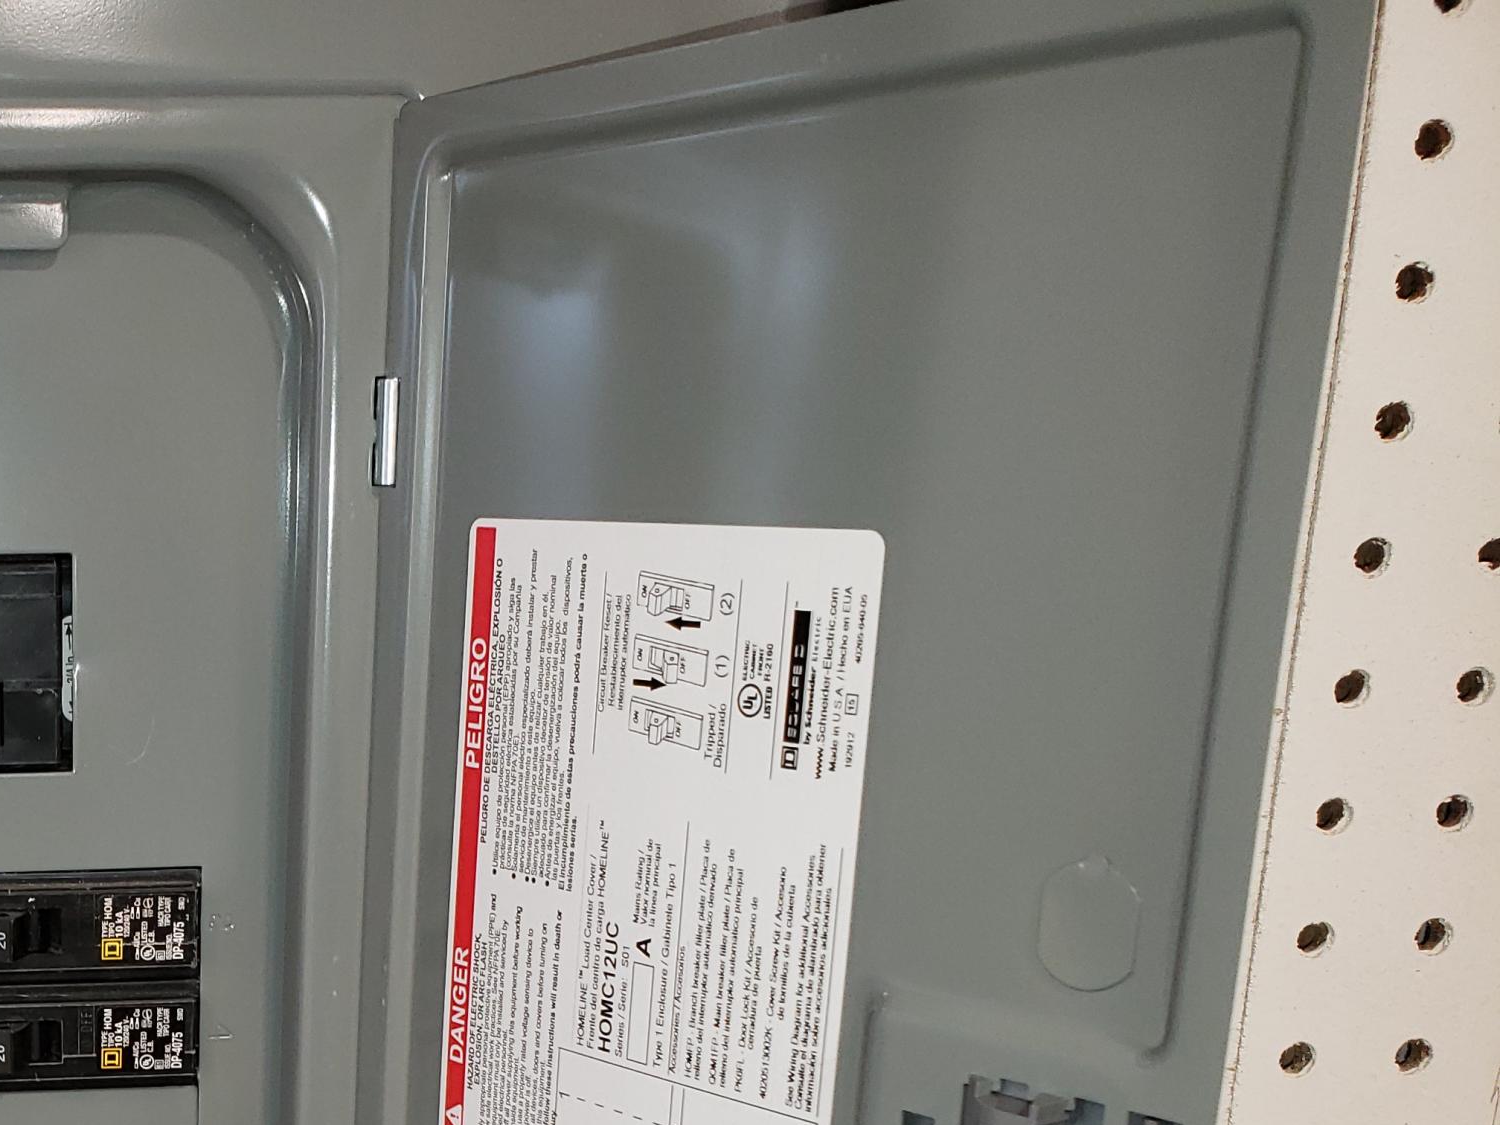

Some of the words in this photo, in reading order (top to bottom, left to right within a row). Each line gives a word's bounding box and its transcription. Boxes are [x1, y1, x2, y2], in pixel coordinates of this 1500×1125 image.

[493, 556, 503, 568] O
[491, 567, 502, 637] EXPLOSIÓN
[603, 599, 612, 631] Reset
[719, 592, 735, 616] (2)
[843, 586, 853, 613] EUA
[811, 616, 821, 662] Electric
[842, 616, 850, 631] en
[600, 634, 609, 676] Breaker
[607, 614, 621, 707] Restablecimiento
[714, 654, 730, 678] (1)
[837, 635, 848, 673] Hecho
[487, 640, 499, 708] ELÉCTRICA,
[617, 656, 627, 711] interruptor
[815, 587, 839, 779] www.Schneider-Electric.com
[465, 637, 487, 769] PELIGRO
[491, 714, 501, 774] DESTELLO
[496, 633, 506, 685] ARQUEO
[598, 678, 606, 713] Circuit
[742, 691, 758, 711] UL
[763, 686, 773, 719] LISTED
[804, 666, 816, 728] Schneider
[484, 710, 494, 774] DESCARGA
[704, 712, 718, 761] Tripped
[713, 703, 726, 768] Disparado
[802, 731, 812, 745] by
[831, 725, 839, 736] in
[828, 739, 838, 772] Made
[483, 776, 490, 792] DE
[480, 794, 489, 844] PELIGRO
[646, 838, 653, 852] de
[587, 862, 596, 896] Cover
[635, 856, 645, 890] Rating
[644, 854, 652, 896] nominal
[665, 873, 676, 898] Tipo
[104, 898, 112, 919] HOM
[115, 912, 123, 923] kA
[556, 909, 562, 921] or
[583, 899, 594, 938] Center
[596, 901, 605, 934] carga
[632, 893, 641, 924] Mains
[640, 898, 649, 924] Valor
[115, 926, 123, 938] 10
[173, 922, 184, 960] DP-4075
[553, 922, 561, 950] death
[593, 937, 601, 951] de
[661, 903, 673, 958] Gabinete
[472, 933, 482, 974] SHOCK,
[479, 941, 488, 977] FLASH
[552, 952, 559, 962] in
[581, 940, 591, 969] Load
[636, 938, 652, 958] A
[592, 954, 600, 990] centro
[597, 921, 619, 1053] HOMC12UC
[449, 947, 469, 1064] DANGER
[469, 975, 480, 1028] ELECTRIC
[477, 1004, 484, 1020] OR
[576, 983, 588, 1046] HOMELINE
[589, 992, 597, 1011] del
[614, 1021, 624, 1058] Series
[621, 945, 630, 968] S01
[655, 968, 668, 1027] Enclosure
[104, 1009, 112, 1029] HOM
[115, 1022, 122, 1033] kA
[586, 1013, 596, 1049] Frente
[115, 1036, 122, 1047] 10
[171, 1032, 183, 1068] DP-4075
[468, 1029, 477, 1045] OF
[473, 1023, 483, 1085] EXPLOSION,
[545, 1012, 556, 1068] instructions
[652, 1040, 663, 1067] Type
[466, 1046, 475, 1090] HAZARD
[543, 1069, 552, 1096] these
